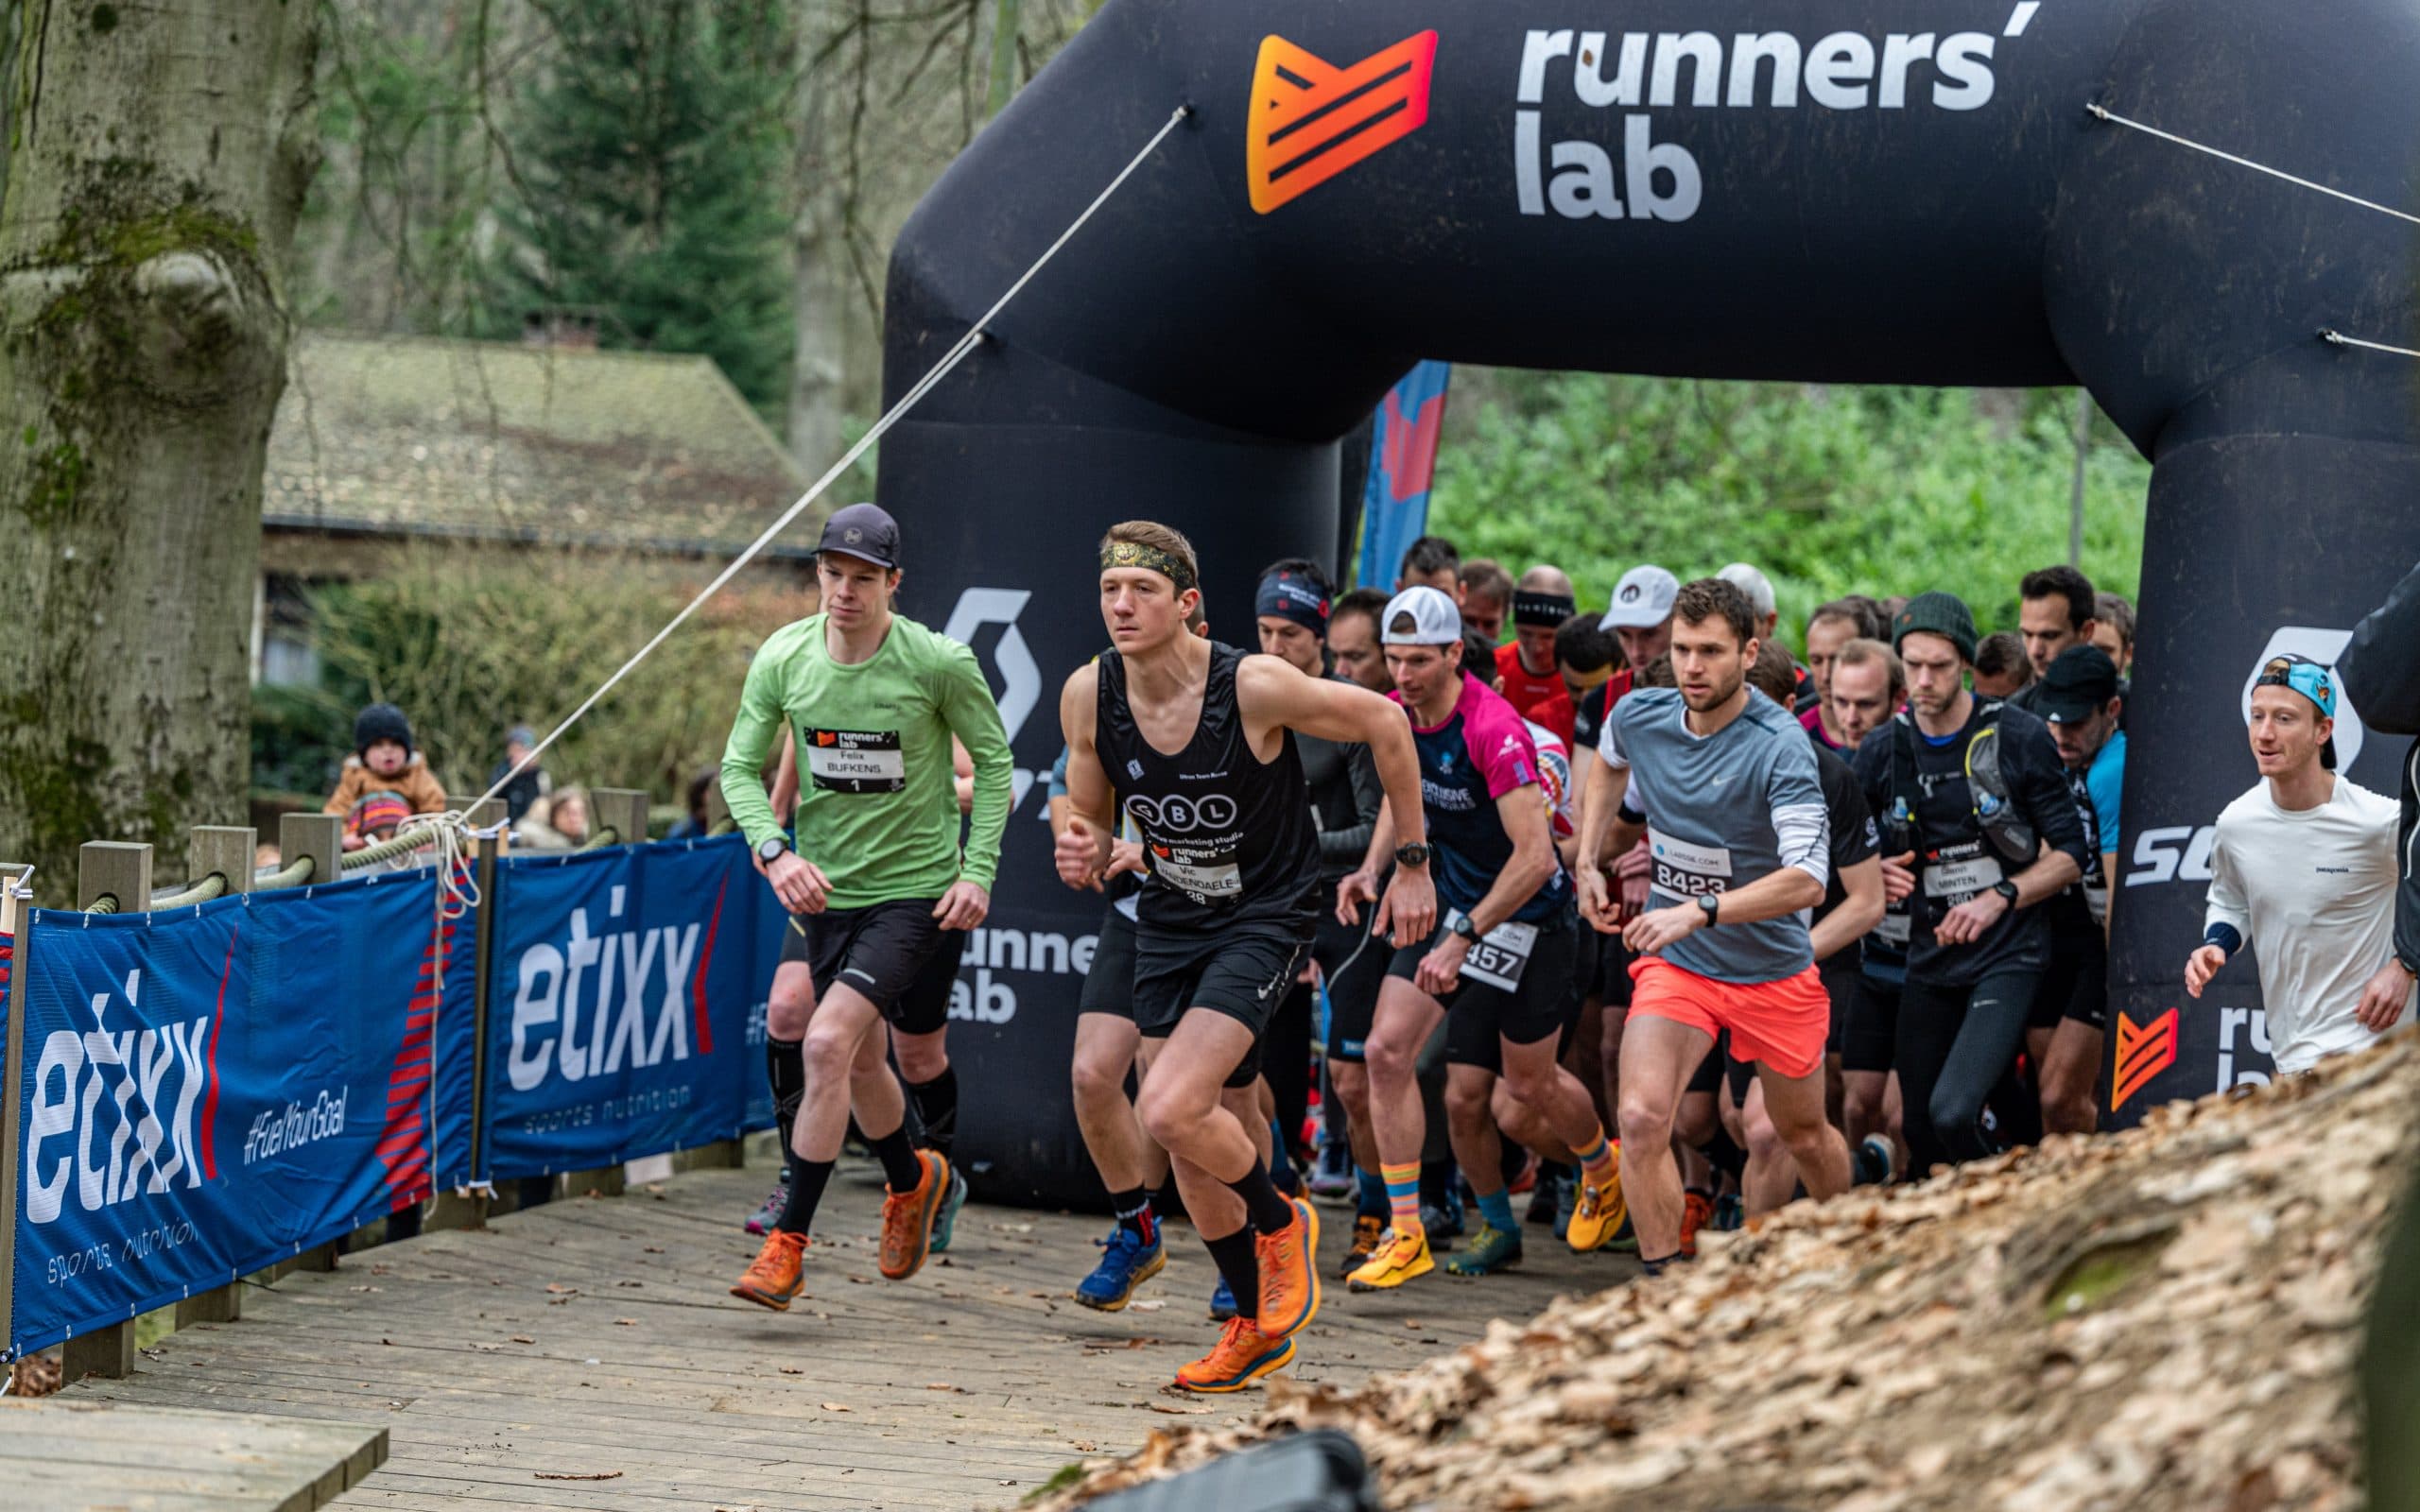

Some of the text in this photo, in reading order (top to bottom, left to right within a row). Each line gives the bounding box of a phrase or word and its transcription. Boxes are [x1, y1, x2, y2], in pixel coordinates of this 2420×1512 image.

[1517, 1, 2040, 111] runners'
[1515, 110, 1703, 223] lab
[838, 731, 885, 742] runners'
[839, 740, 858, 748] lab
[840, 751, 864, 760] Felix
[851, 779, 860, 792] 1
[1168, 832, 1244, 847] marketing studio
[1172, 847, 1219, 858] runners'
[1174, 853, 1192, 865] lab
[1657, 864, 1725, 895] 8423
[959, 928, 1099, 975] unne
[1466, 943, 1519, 975] 457
[508, 885, 700, 1091] etixx
[946, 968, 1017, 1024] ab
[26, 969, 208, 1224] etixx
[603, 1085, 690, 1119] nutrition
[244, 1084, 348, 1165] #FuelYourGoal
[48, 1217, 199, 1288] sports nutrition
